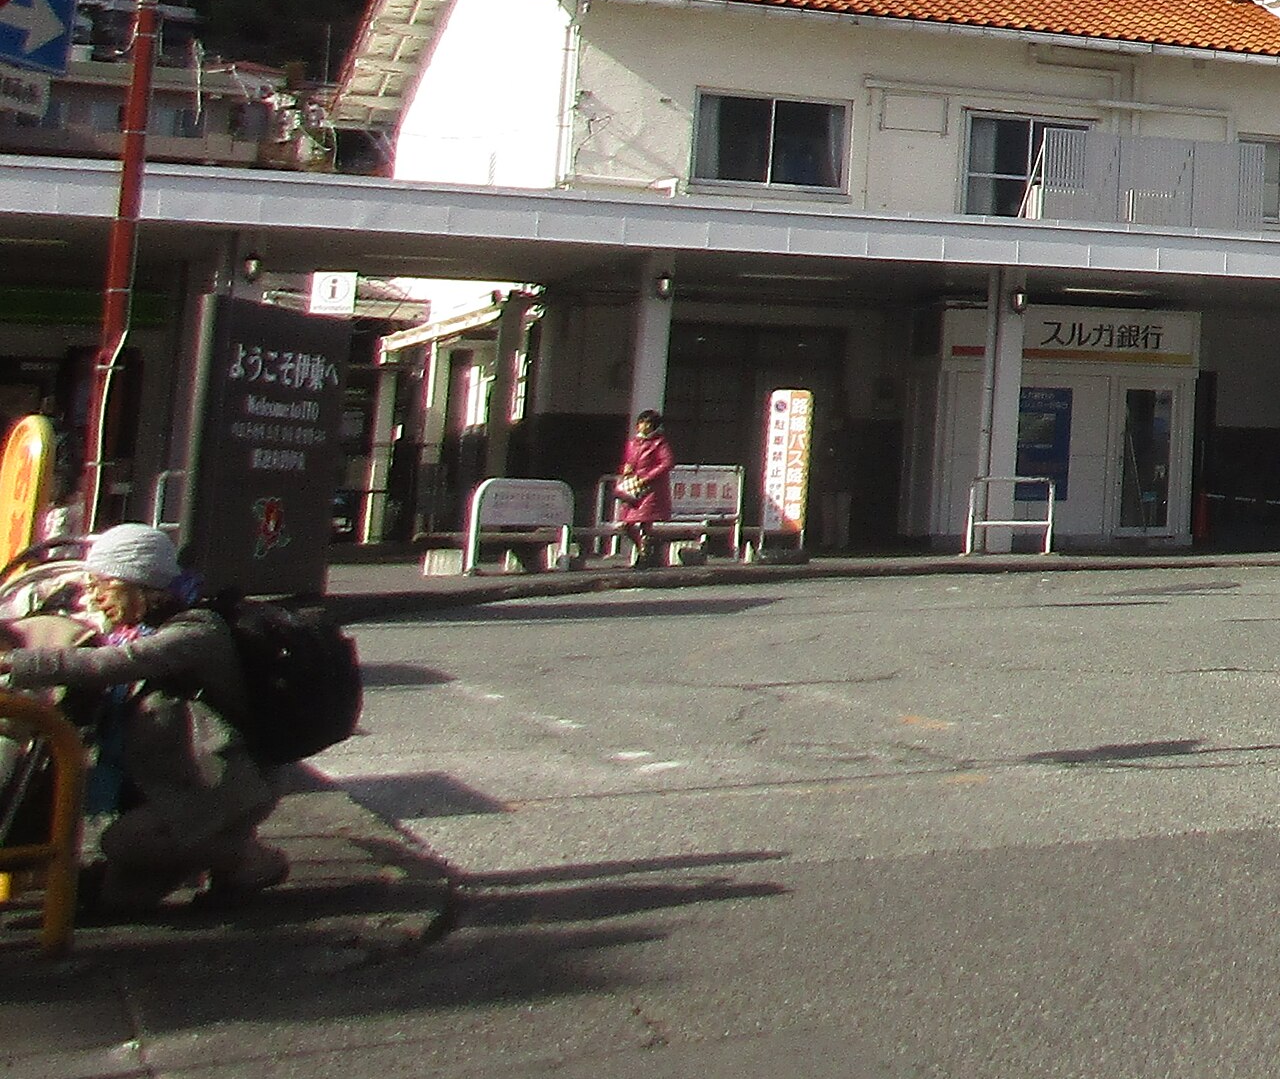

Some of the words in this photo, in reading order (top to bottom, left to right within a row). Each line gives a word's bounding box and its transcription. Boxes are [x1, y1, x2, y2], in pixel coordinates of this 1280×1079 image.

[1040, 321, 1164, 350] スルガ銀行
[228, 343, 339, 391] ようこそ伊東へ
